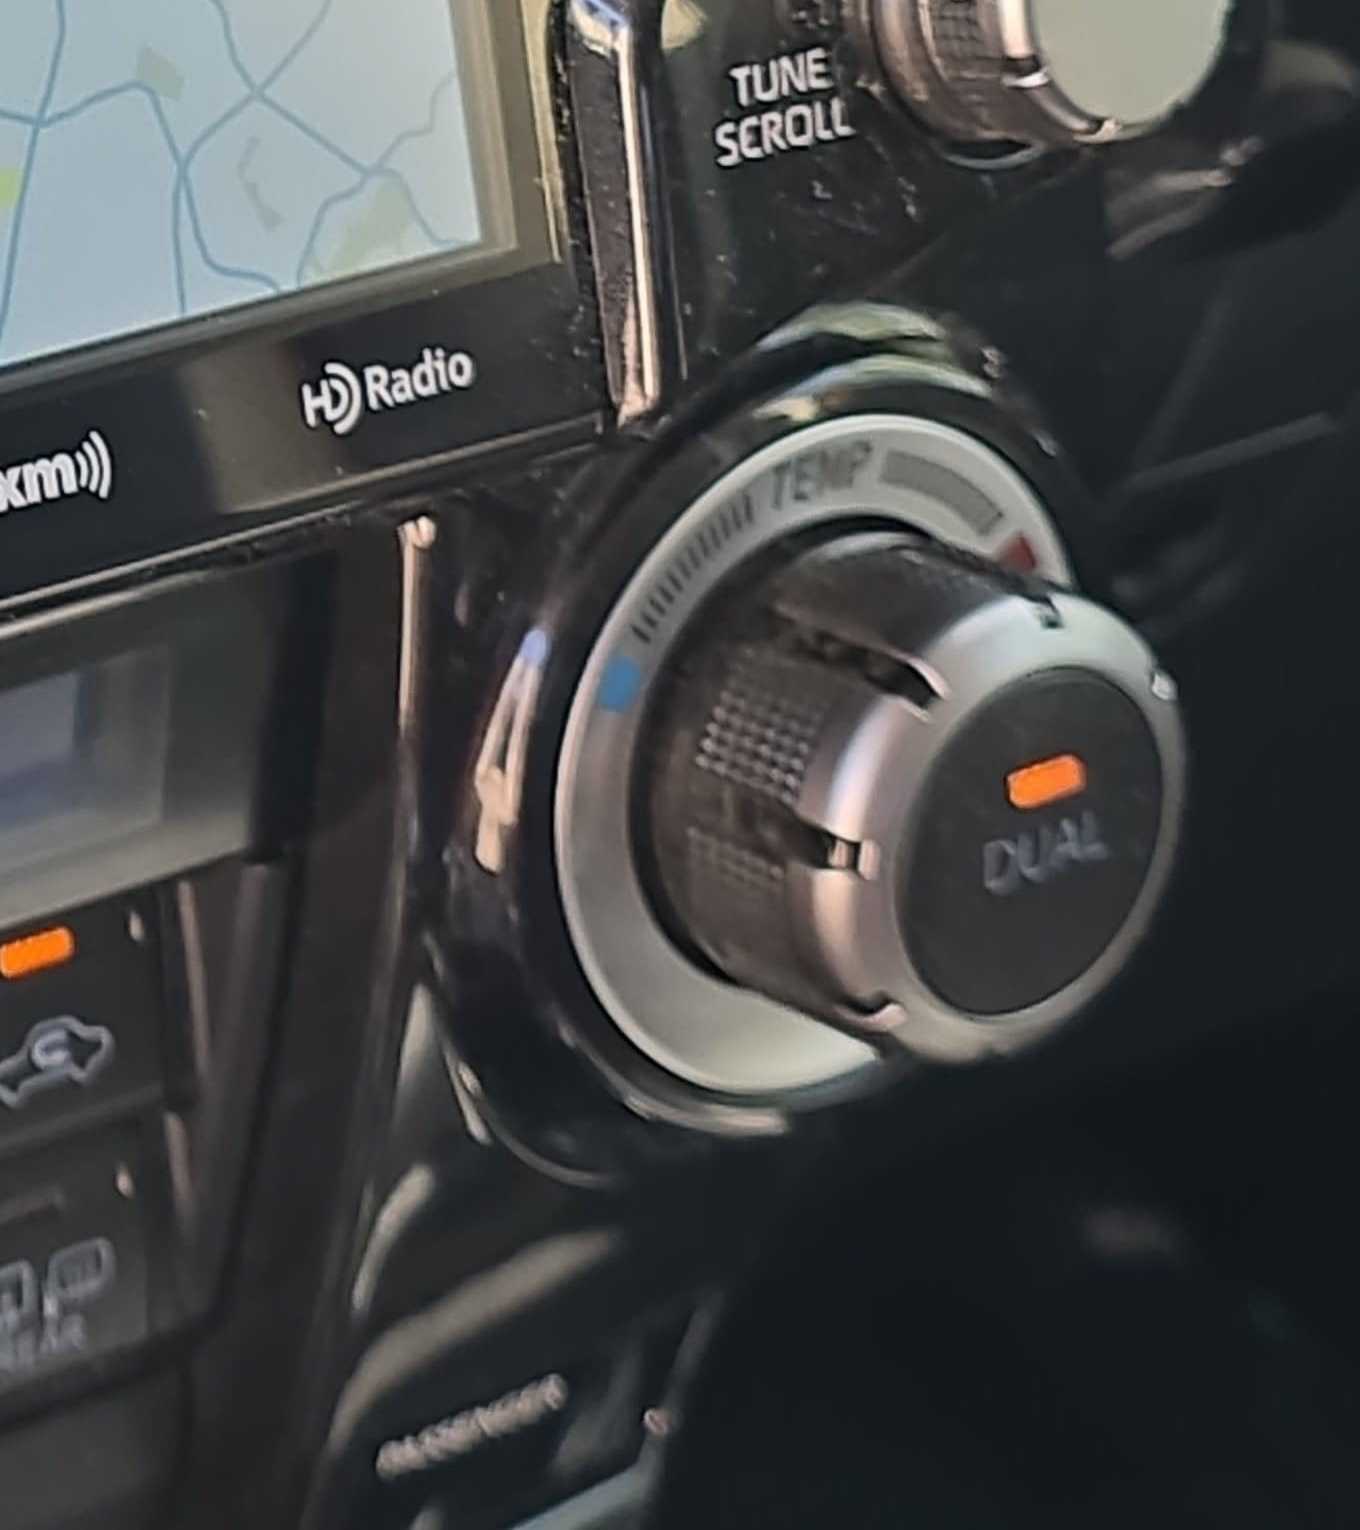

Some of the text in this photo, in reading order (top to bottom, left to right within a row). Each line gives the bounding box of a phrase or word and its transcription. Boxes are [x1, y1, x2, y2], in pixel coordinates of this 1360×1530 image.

[729, 47, 835, 110] TUNE
[714, 98, 856, 170] SCROLL
[302, 348, 475, 434] HD Radio
[770, 438, 872, 512] TEMP
[983, 810, 1110, 895] DUAL
